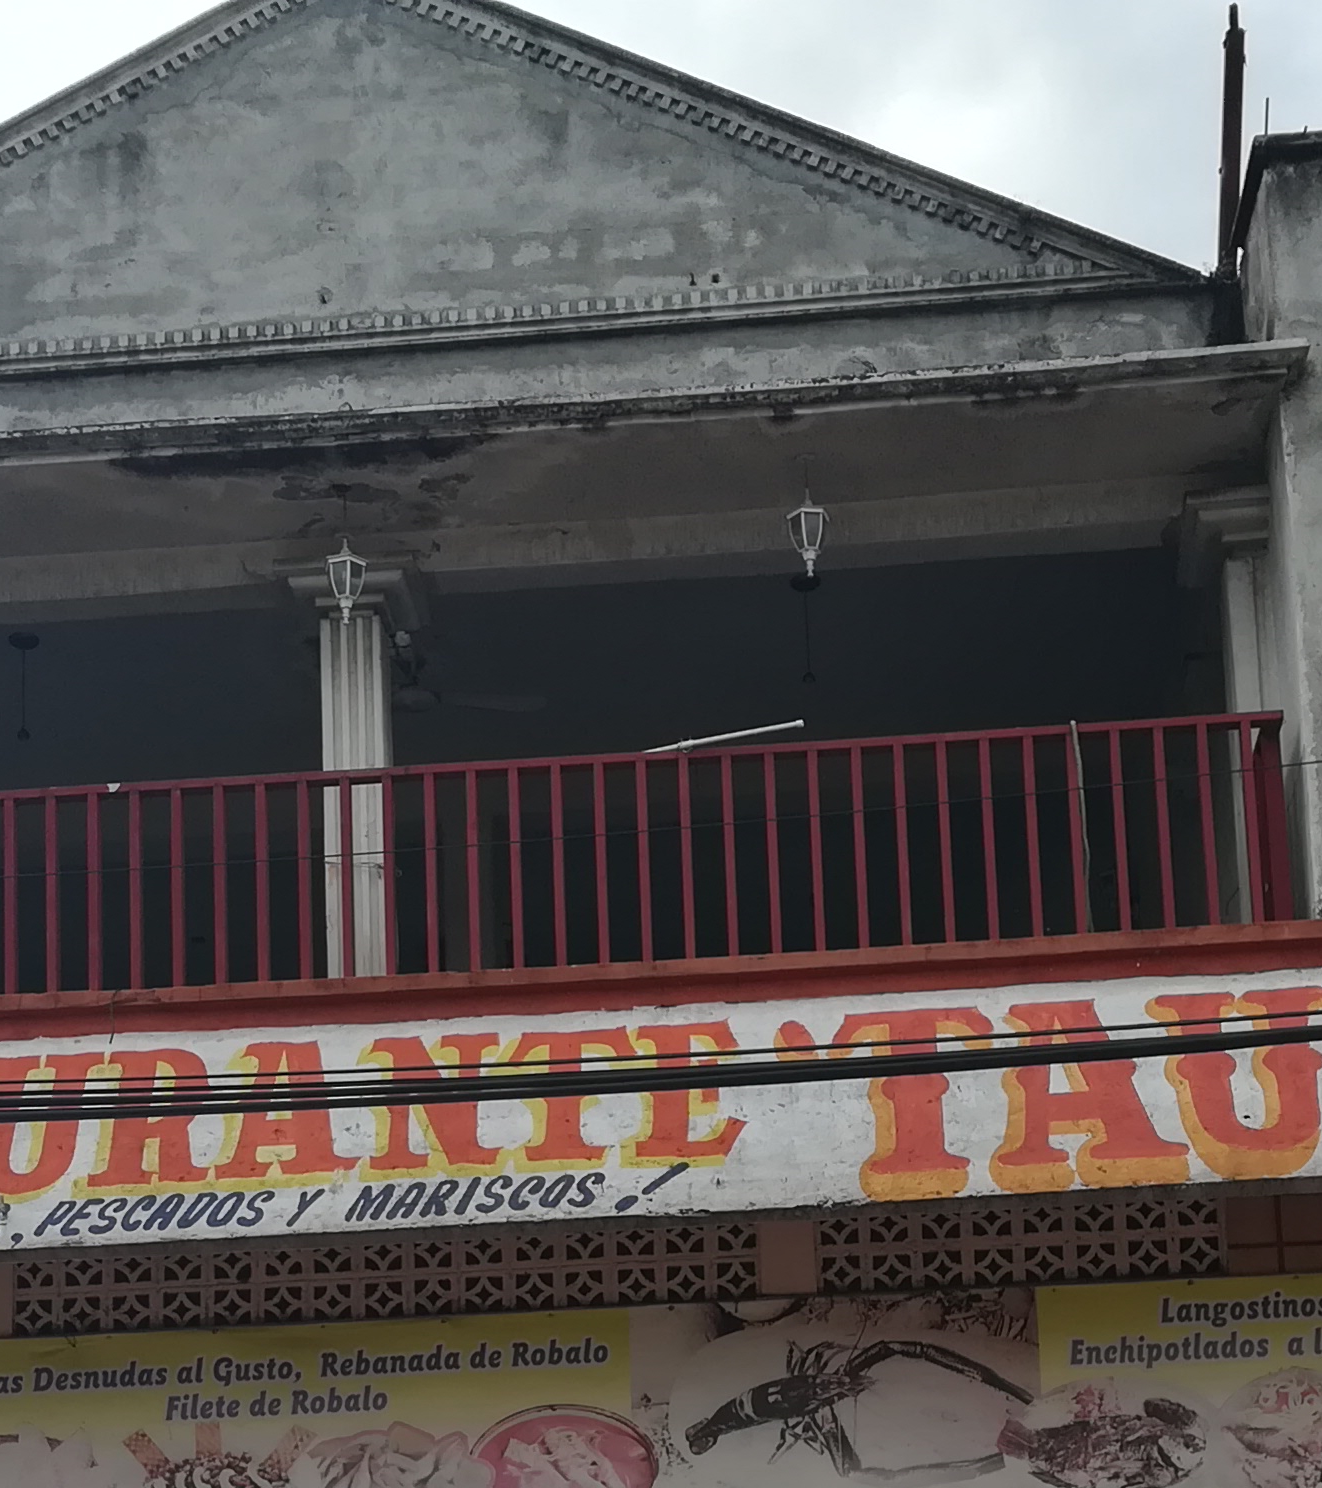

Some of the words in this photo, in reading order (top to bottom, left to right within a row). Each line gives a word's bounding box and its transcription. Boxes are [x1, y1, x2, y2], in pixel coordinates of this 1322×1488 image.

[34, 1188, 270, 1239] PESCADOS
[286, 1187, 329, 1228] Y
[32, 1357, 168, 1395] Desnudas
[176, 1356, 205, 1385] al
[212, 1353, 303, 1387] Gusto,
[318, 1346, 462, 1382] Rebanada
[469, 1344, 503, 1371] de
[510, 1337, 610, 1369] Robalo
[1068, 1326, 1270, 1372] Enchipotlados
[1286, 1336, 1305, 1358] a
[164, 1391, 241, 1424] Filete
[249, 1387, 283, 1418] de
[289, 1384, 390, 1416] Robalo
